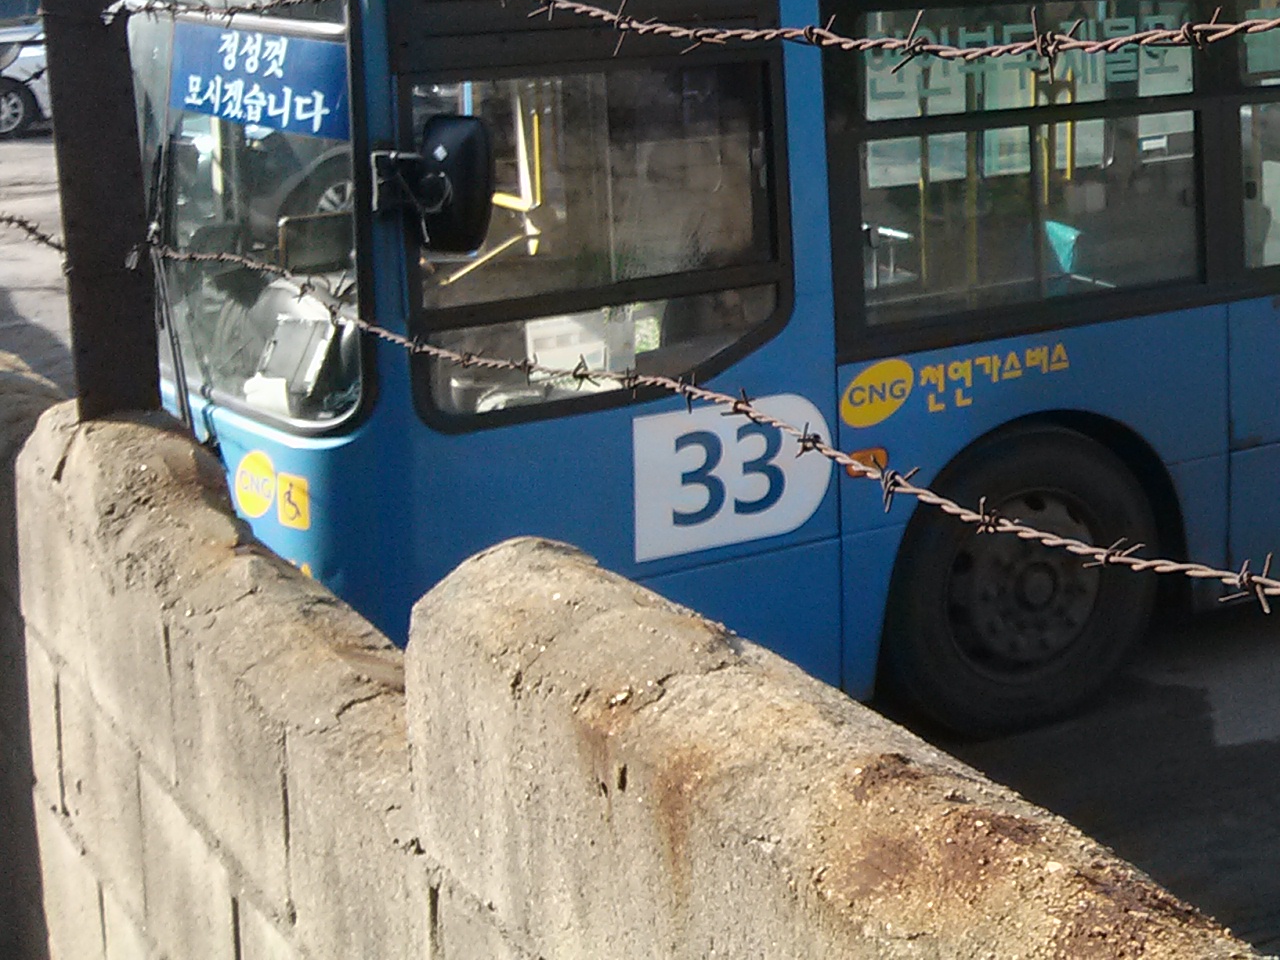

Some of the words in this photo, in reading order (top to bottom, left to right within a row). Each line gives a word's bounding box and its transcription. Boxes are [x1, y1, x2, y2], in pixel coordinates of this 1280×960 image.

[219, 30, 289, 79] 정성껏
[184, 74, 330, 134] 모시겠습니다
[848, 378, 907, 407] CNG
[919, 343, 1070, 413] 천연가스버스
[239, 469, 272, 499] CNG
[672, 423, 786, 527] 33
